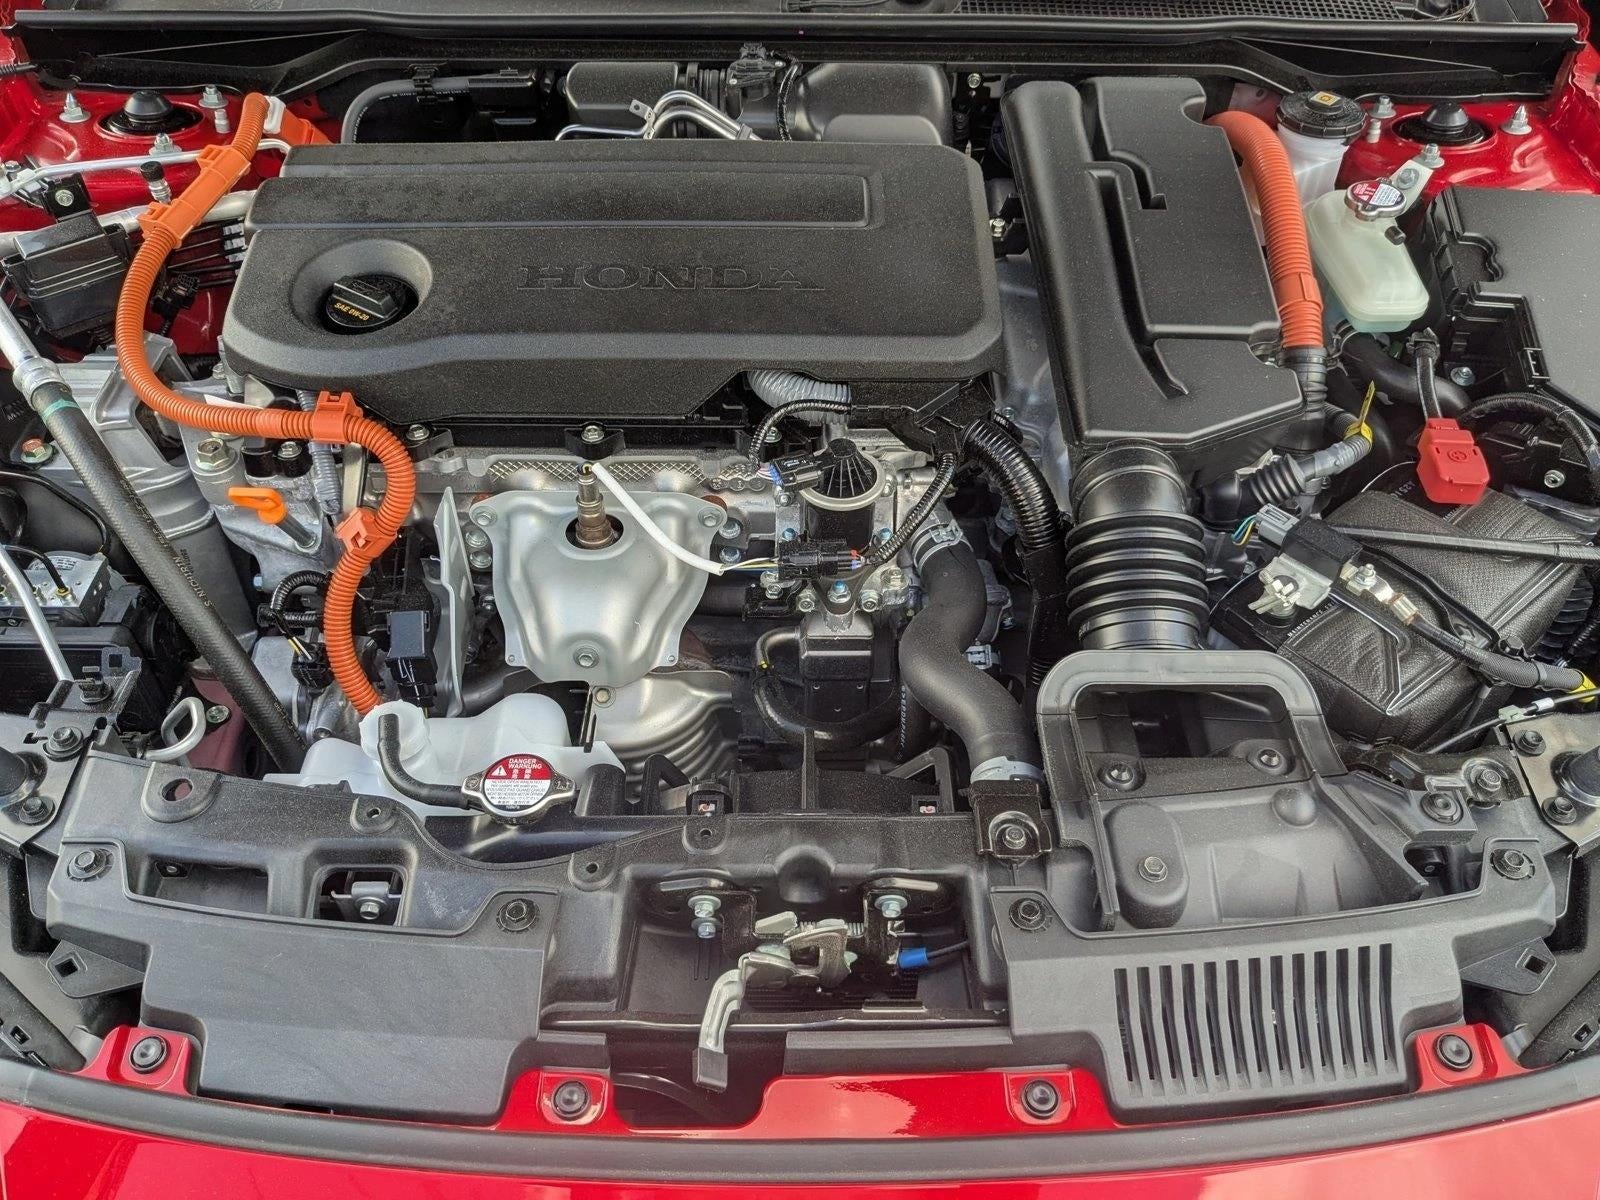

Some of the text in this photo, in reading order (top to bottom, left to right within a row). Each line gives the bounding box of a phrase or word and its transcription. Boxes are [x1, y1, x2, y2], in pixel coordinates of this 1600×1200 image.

[517, 266, 824, 291] HONDA
[334, 302, 370, 321] SAE 0W-20
